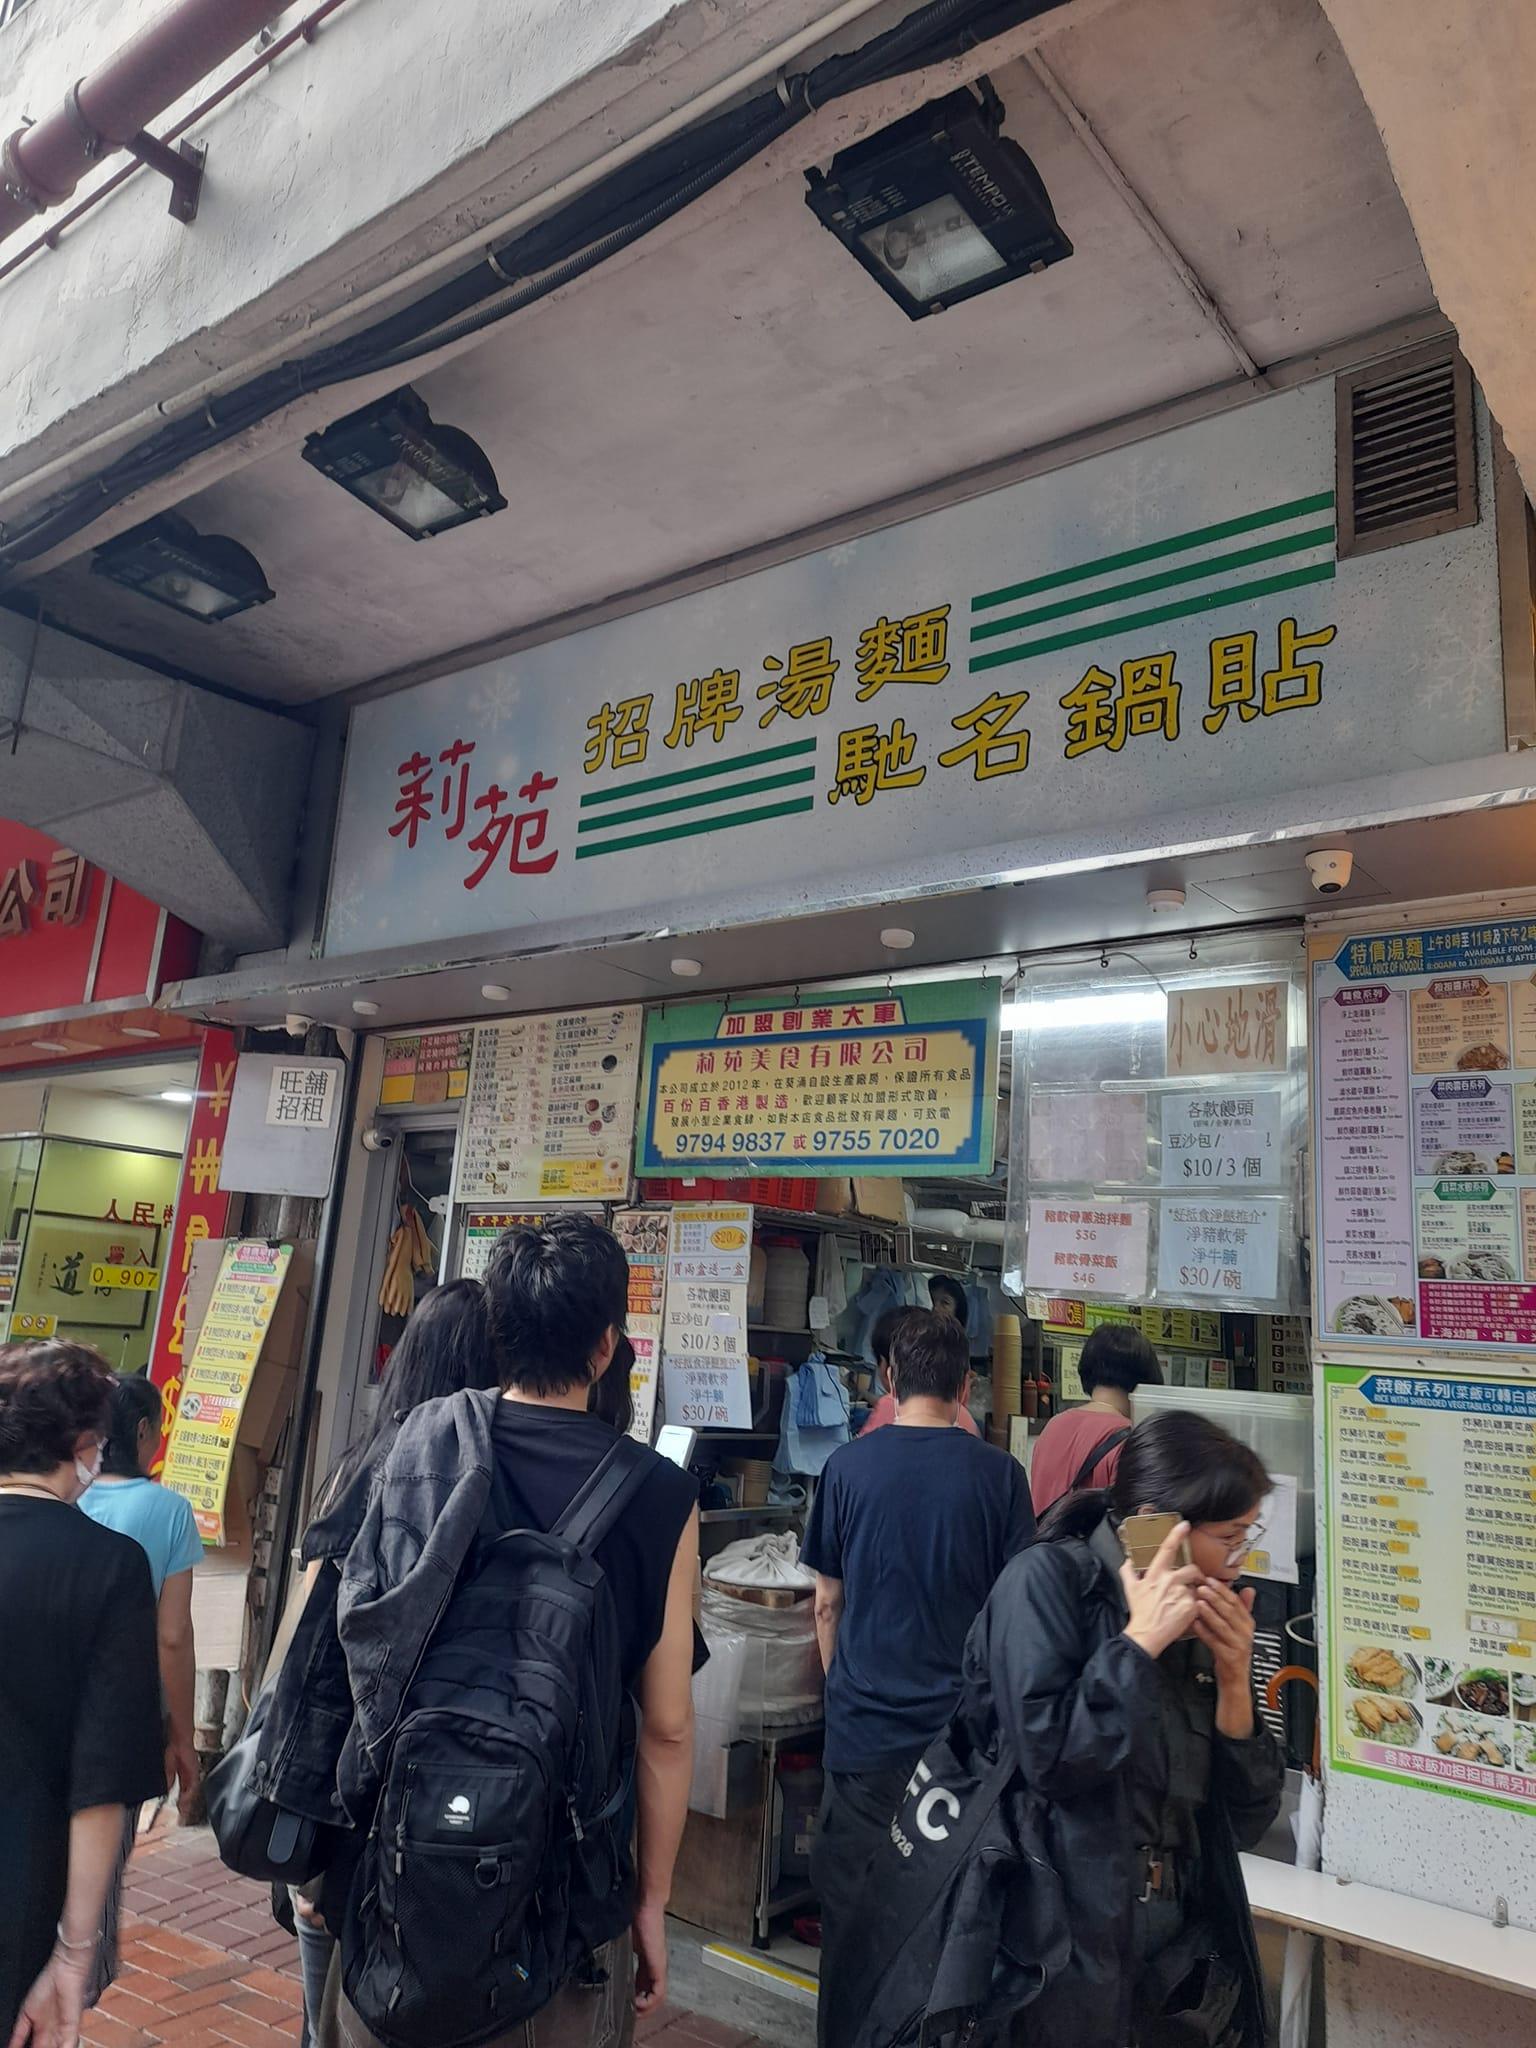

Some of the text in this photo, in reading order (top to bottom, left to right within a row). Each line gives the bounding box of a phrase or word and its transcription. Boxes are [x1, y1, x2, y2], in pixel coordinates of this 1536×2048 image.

[583, 603, 952, 774] 招牌湯麵
[828, 617, 1337, 806] 馳名鍋貼
[388, 739, 559, 890] 莉苑
[0, 847, 86, 936] 公司
[1464, 944, 1533, 958] AVAILABLE FROM
[726, 1002, 897, 1036] 加盟創業大軍
[1170, 986, 1281, 1069] 小心地滑
[276, 1095, 323, 1122] 招租
[676, 1128, 939, 1153] 9794 9837 或 9755 7020
[1072, 1272, 1096, 1284] $46
